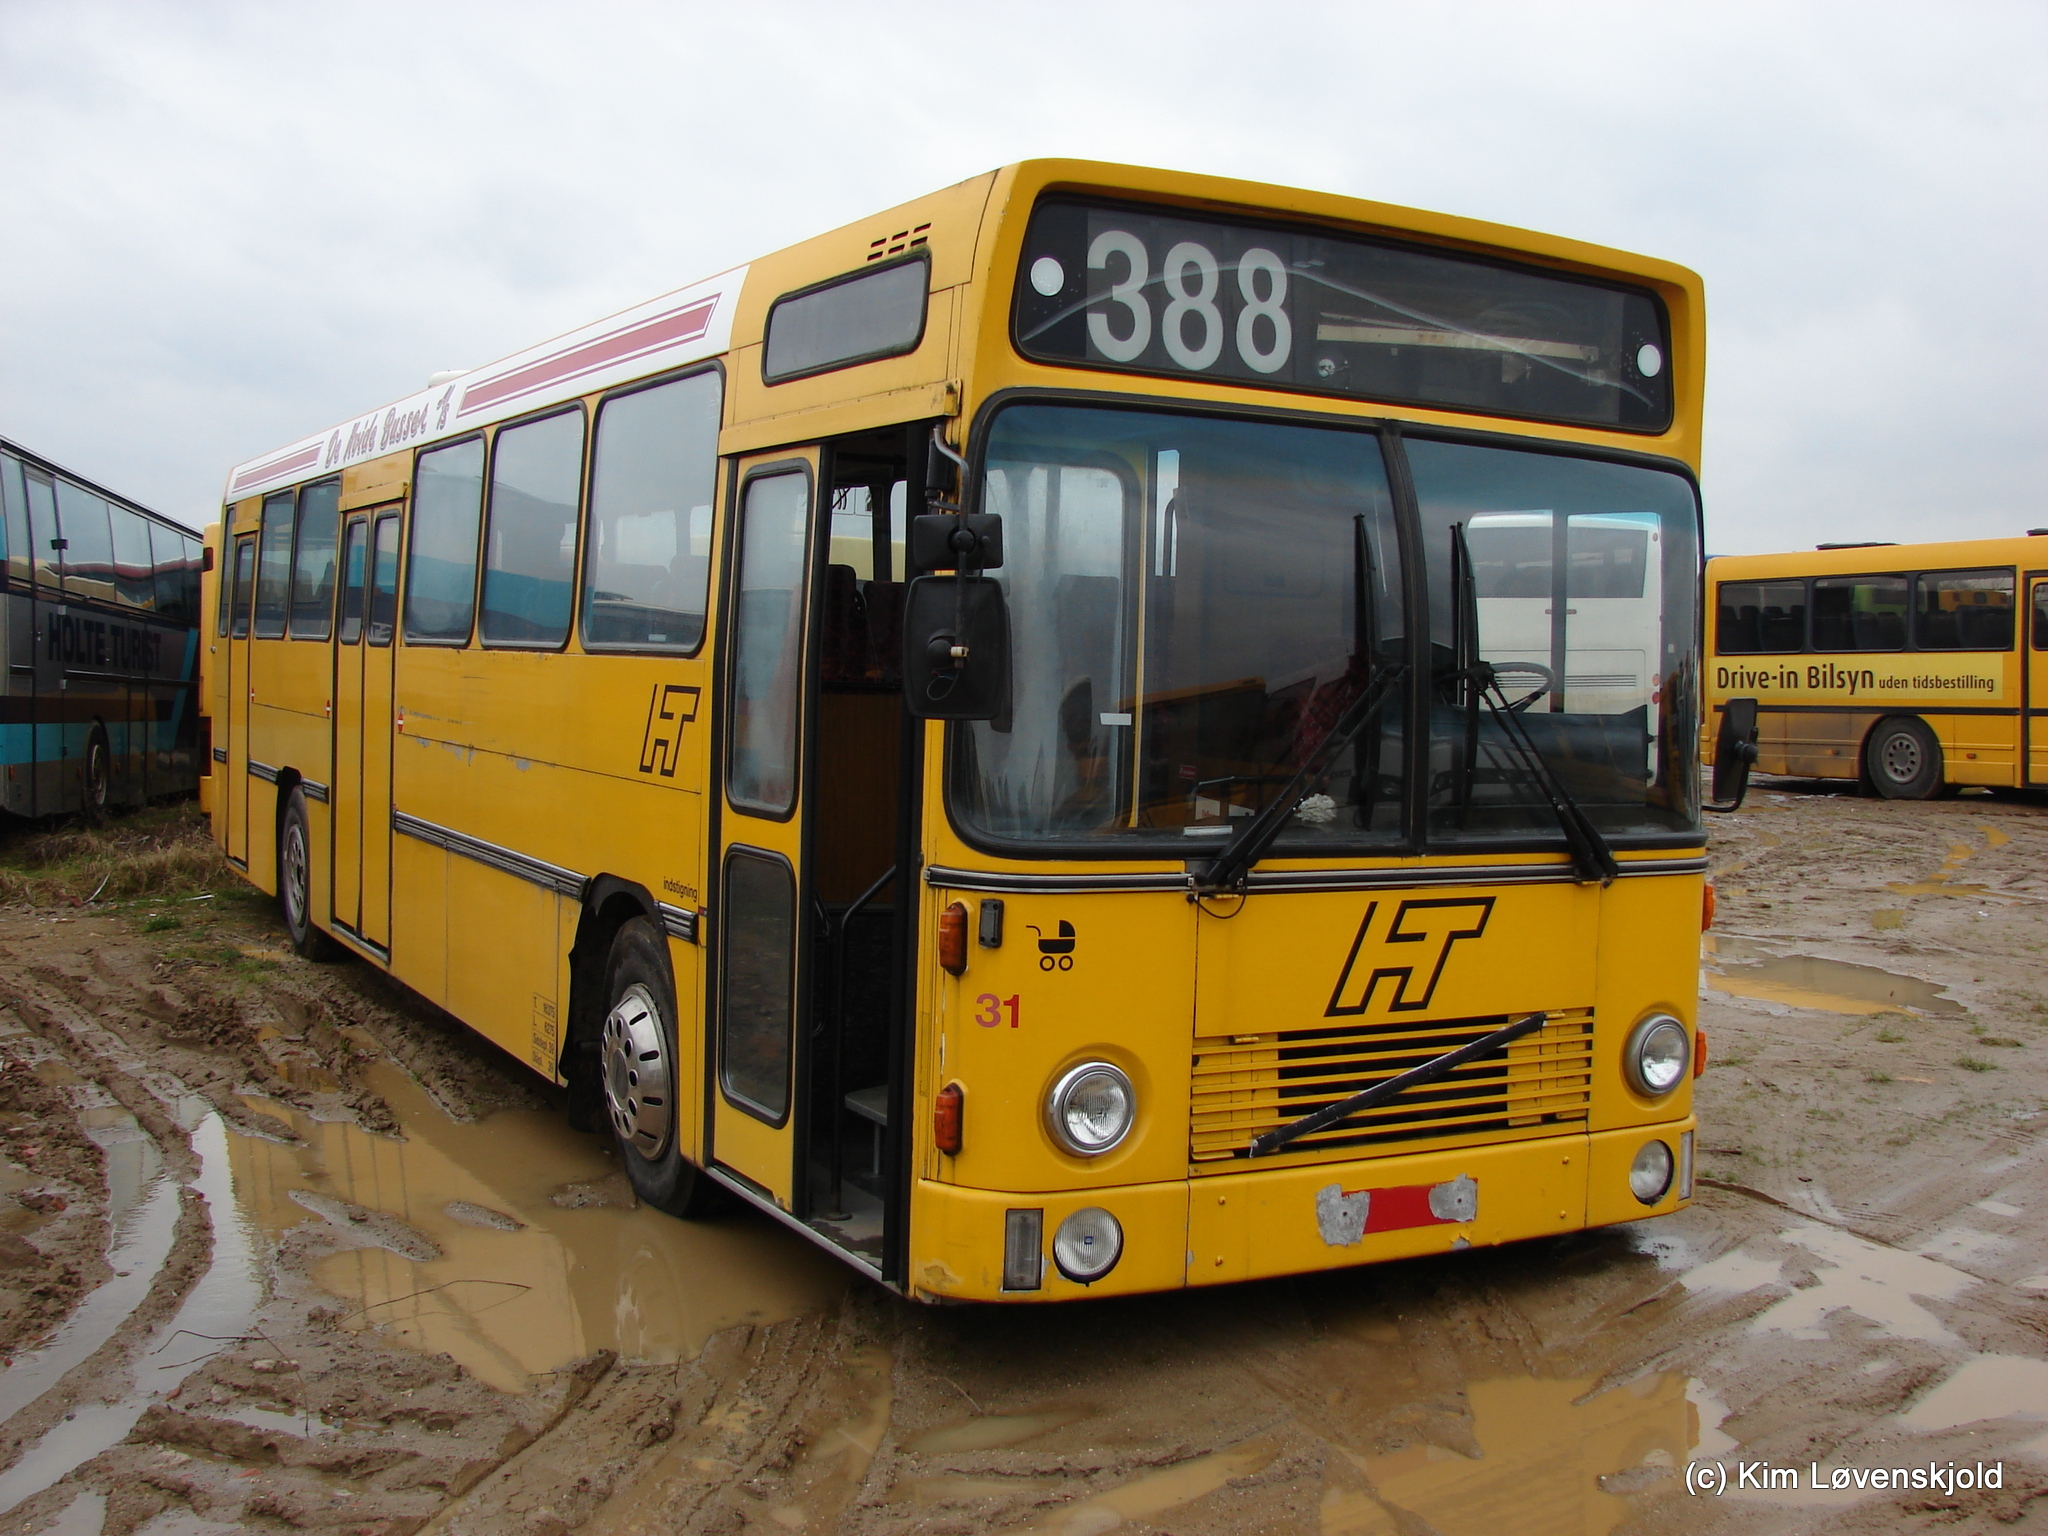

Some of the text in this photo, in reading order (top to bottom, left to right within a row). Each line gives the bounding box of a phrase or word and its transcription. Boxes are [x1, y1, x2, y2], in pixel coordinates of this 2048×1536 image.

[1087, 229, 1292, 374] 388
[380, 402, 429, 451] Busser
[48, 612, 162, 672] HOLTE TURIST
[1717, 661, 1994, 695] Drive-in Bilsyn uden tidsbestilling
[639, 684, 702, 777] HT
[663, 875, 698, 903] indstigning
[1323, 895, 1496, 1017] HT
[974, 992, 1020, 1030] 31
